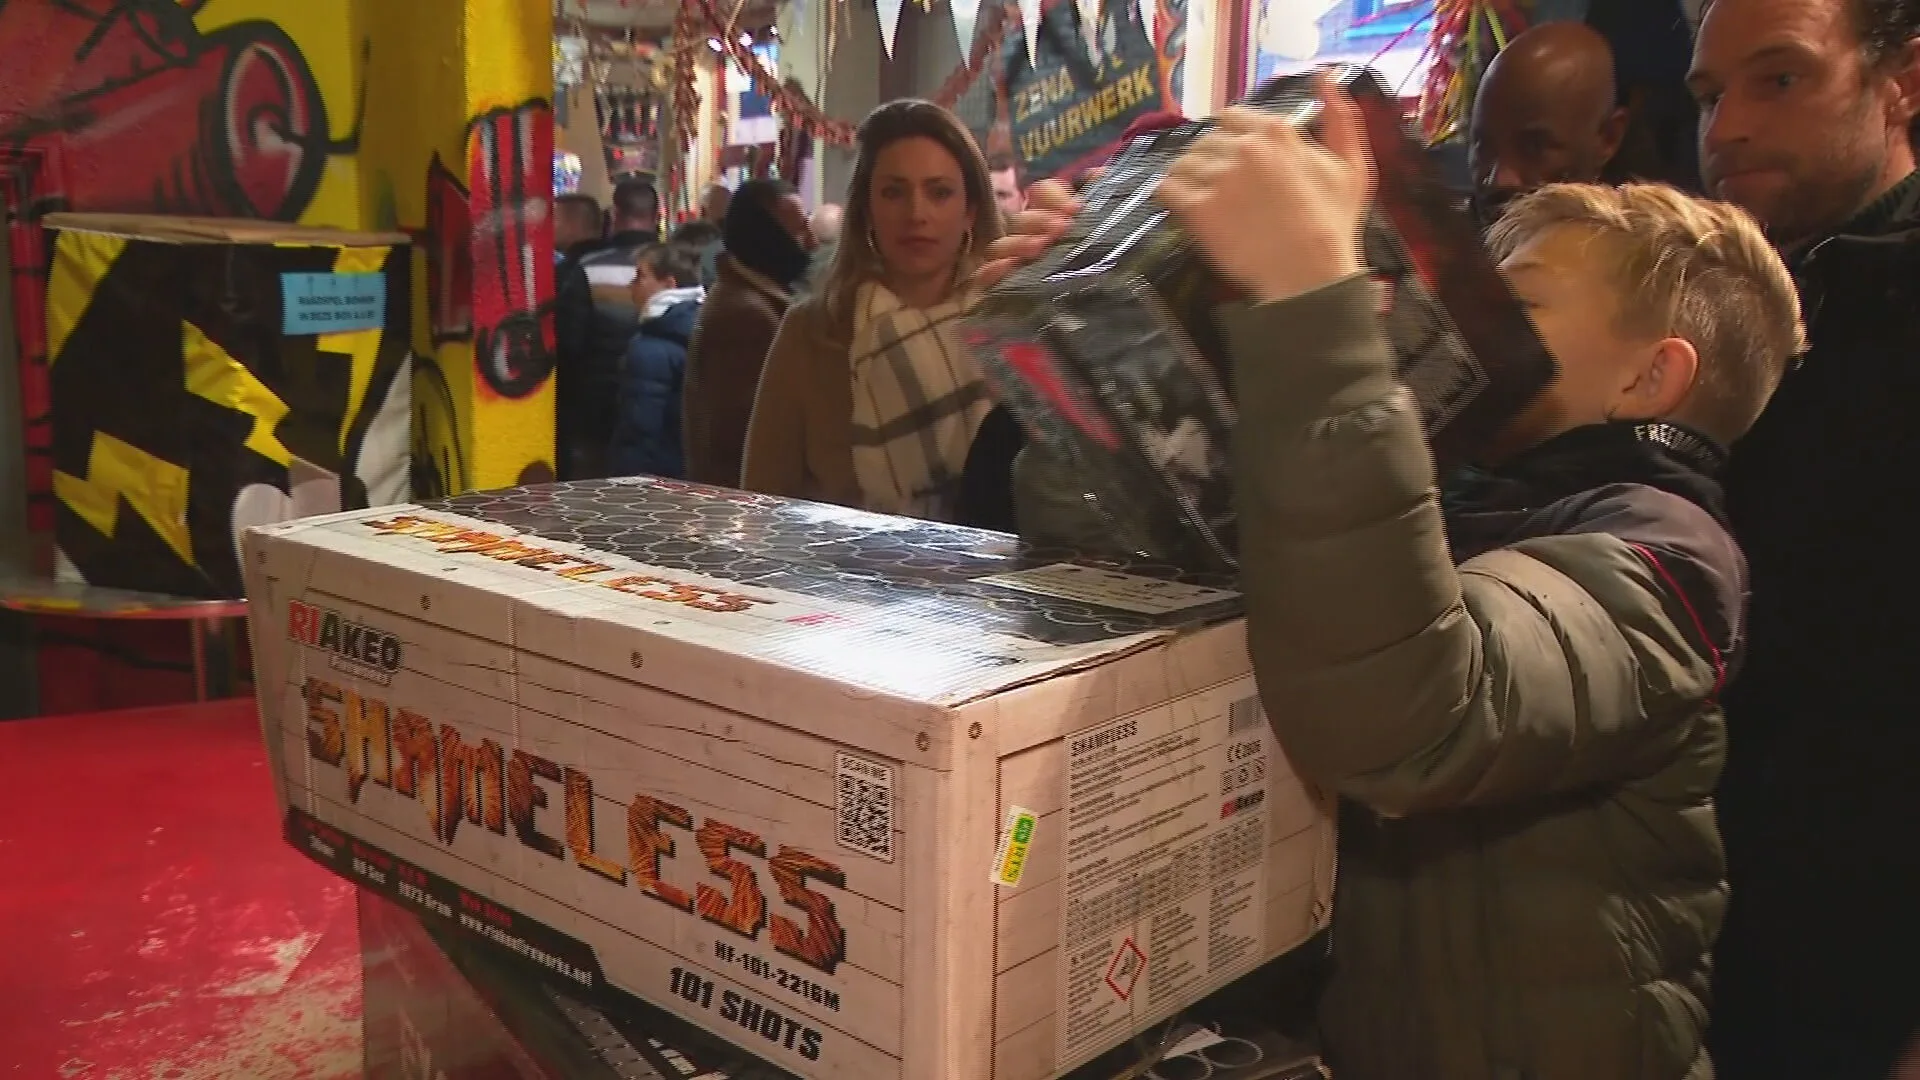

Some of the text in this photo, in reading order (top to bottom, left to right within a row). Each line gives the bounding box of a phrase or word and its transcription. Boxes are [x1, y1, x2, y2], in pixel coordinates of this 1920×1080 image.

[1014, 65, 1074, 123] ZENA
[1019, 63, 1154, 161] VUURWERK
[362, 515, 777, 613] SHAMELESS
[286, 599, 401, 672] RIAKEO
[840, 757, 887, 781] SCAN ME
[1071, 720, 1137, 757] SHAMELESS
[302, 675, 847, 976] SHAMELESS
[1220, 789, 1265, 820] RIAKEO
[669, 966, 715, 1009] 101
[719, 989, 823, 1061] SHOTS
